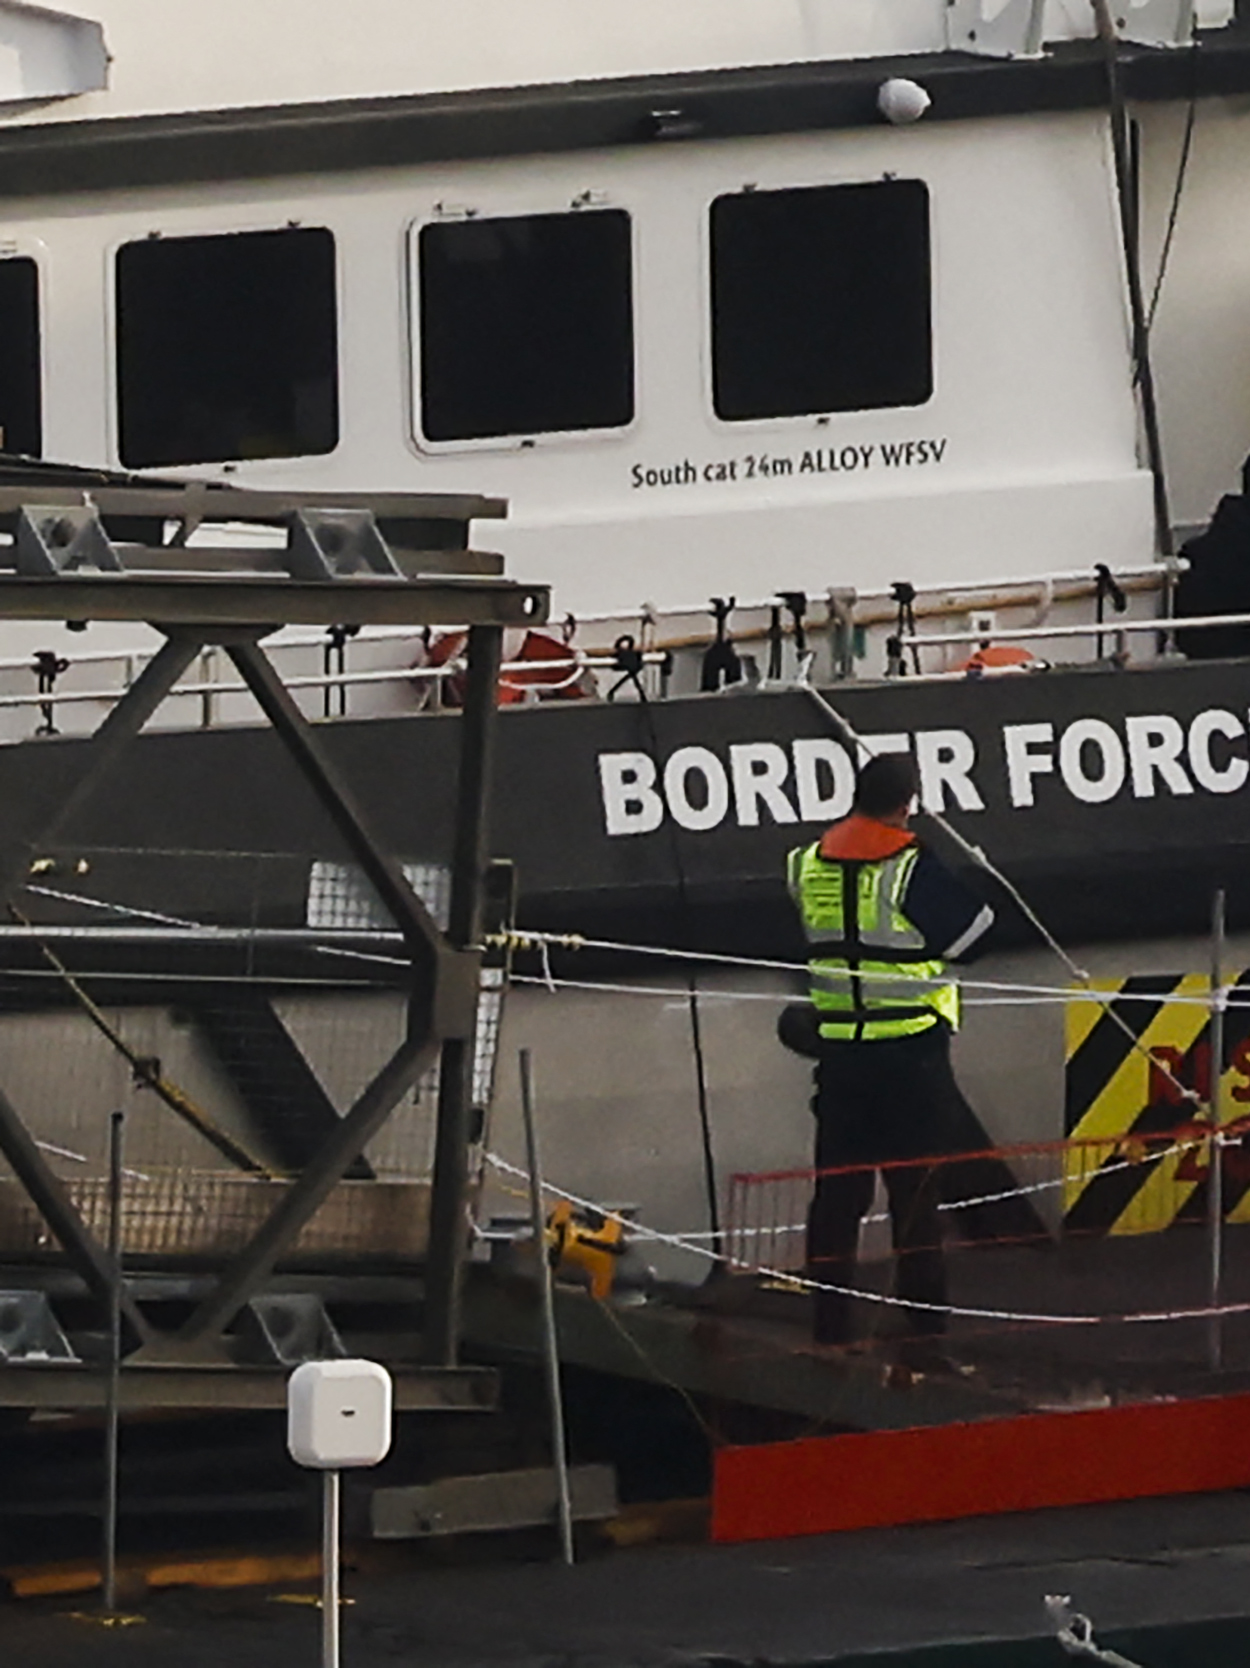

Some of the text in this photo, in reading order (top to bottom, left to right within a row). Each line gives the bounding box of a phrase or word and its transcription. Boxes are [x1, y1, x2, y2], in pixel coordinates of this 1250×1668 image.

[631, 438, 947, 488] South cat 24m ALLOY WFSV
